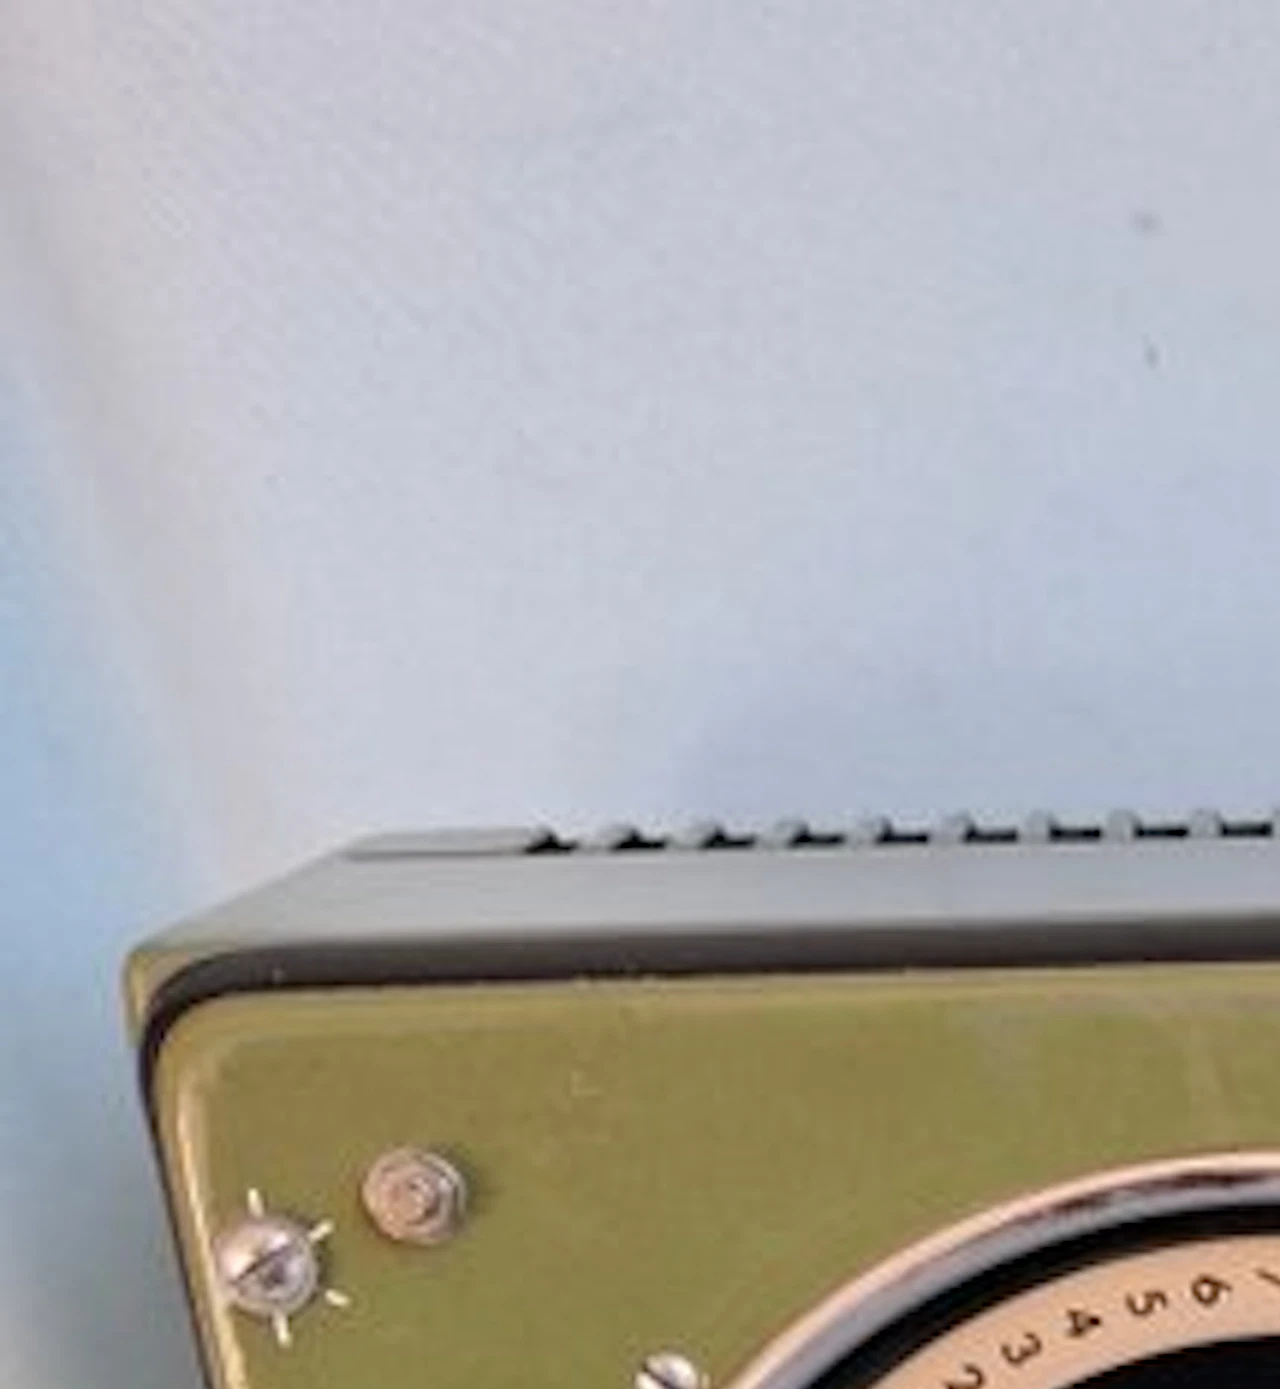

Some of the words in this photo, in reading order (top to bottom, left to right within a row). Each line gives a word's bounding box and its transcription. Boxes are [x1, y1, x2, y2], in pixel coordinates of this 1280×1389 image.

[1125, 1291, 1168, 1316] 5
[1190, 1275, 1234, 1308] 6
[1065, 1308, 1101, 1338] 4
[1001, 1332, 1042, 1365] 3
